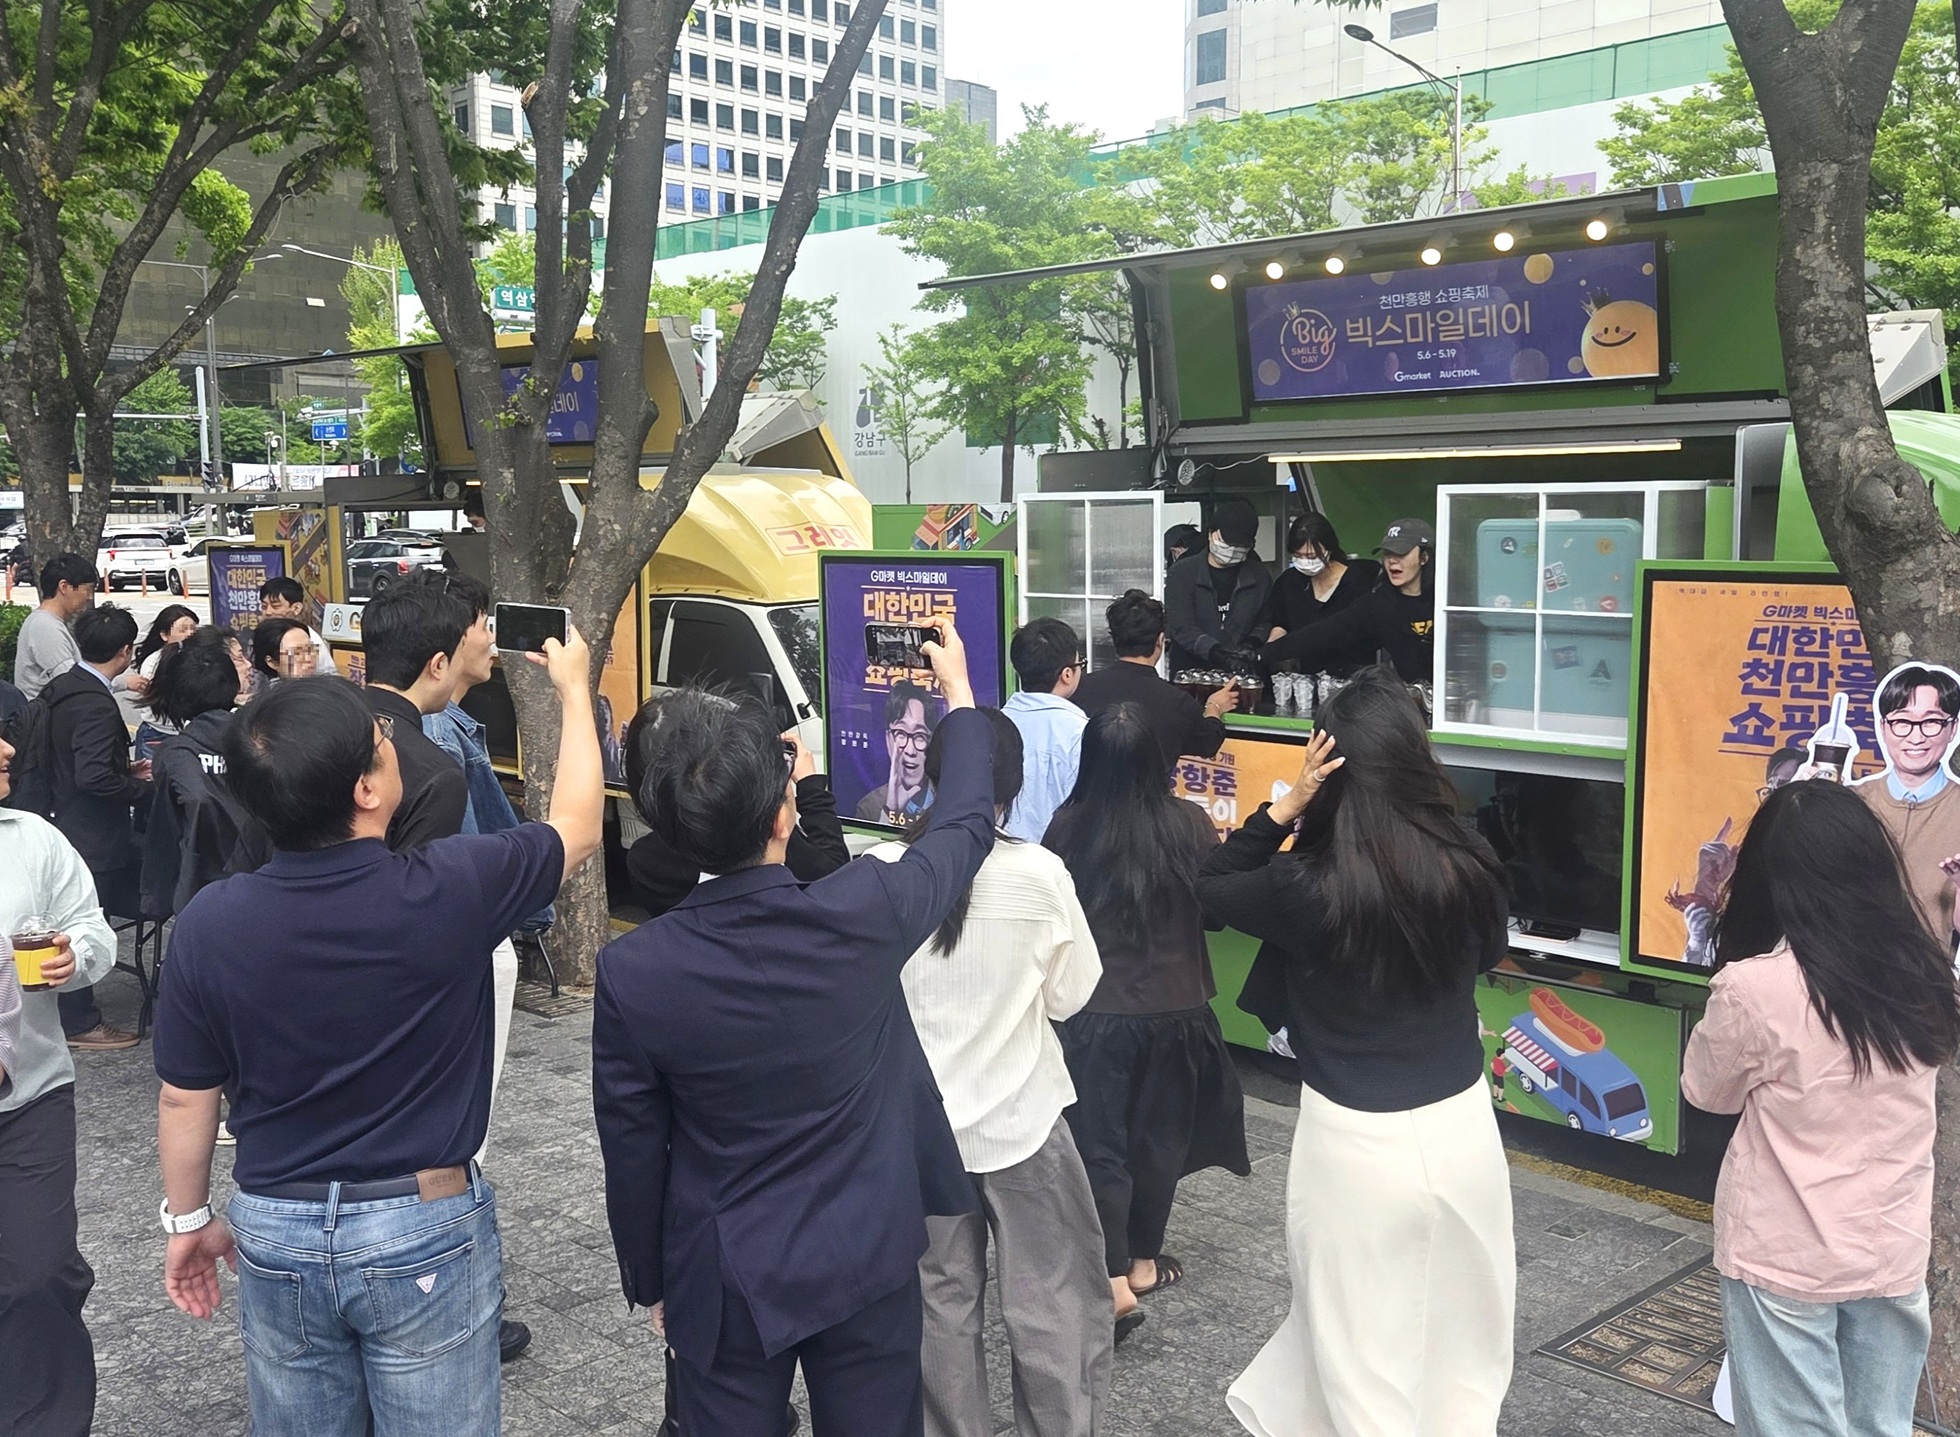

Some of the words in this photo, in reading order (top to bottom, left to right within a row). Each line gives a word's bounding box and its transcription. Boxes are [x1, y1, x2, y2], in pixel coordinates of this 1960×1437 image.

[1379, 290, 1431, 310] 천만흥행
[1435, 284, 1489, 304] 쇼핑축제
[1345, 300, 1531, 348] 빅스마일데이
[1292, 317, 1337, 355] Big
[1291, 346, 1318, 356] SMILE
[1301, 355, 1319, 364] DAY
[1394, 371, 1431, 382] Gmarket
[550, 391, 580, 413] 데이
[854, 431, 887, 448] 강남구
[775, 524, 856, 551] 그레잇
[226, 568, 266, 589] 대한민국
[870, 570, 895, 583] G마켓
[897, 571, 947, 584] 빅스마일데이
[863, 591, 956, 625] 대한민국
[1762, 605, 1808, 619] G마켓
[889, 811, 906, 826] 5.6
